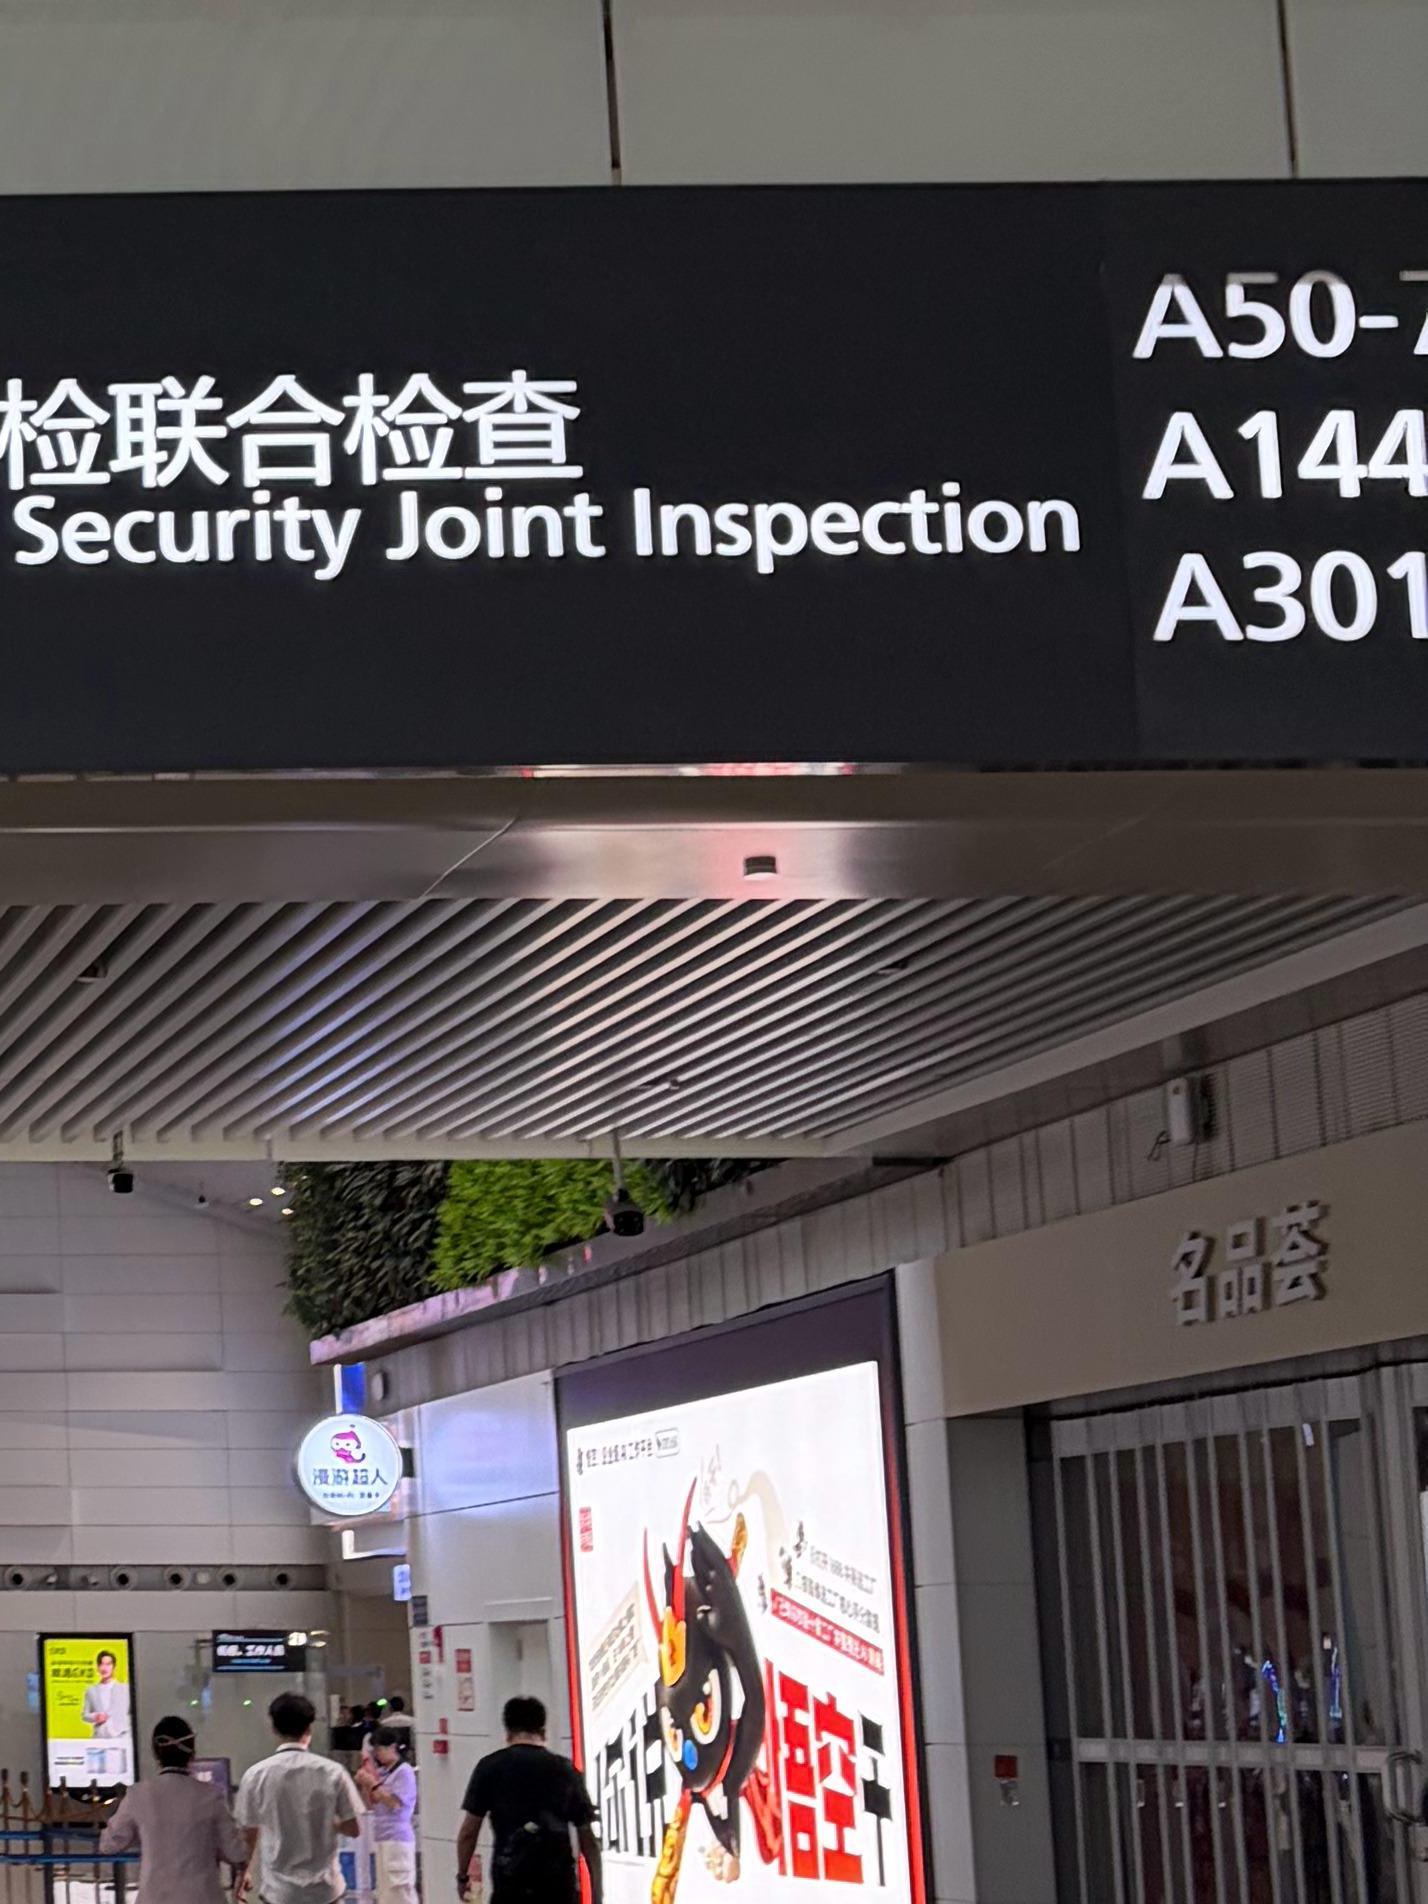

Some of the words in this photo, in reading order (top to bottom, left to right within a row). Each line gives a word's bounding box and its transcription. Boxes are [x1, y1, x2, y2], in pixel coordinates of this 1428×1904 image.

[12, 489, 363, 582] Security
[383, 487, 607, 563] Joint
[632, 481, 1083, 576] Inspection
[1166, 1200, 1333, 1327] 名品荟
[312, 1468, 389, 1486] 漫游超人
